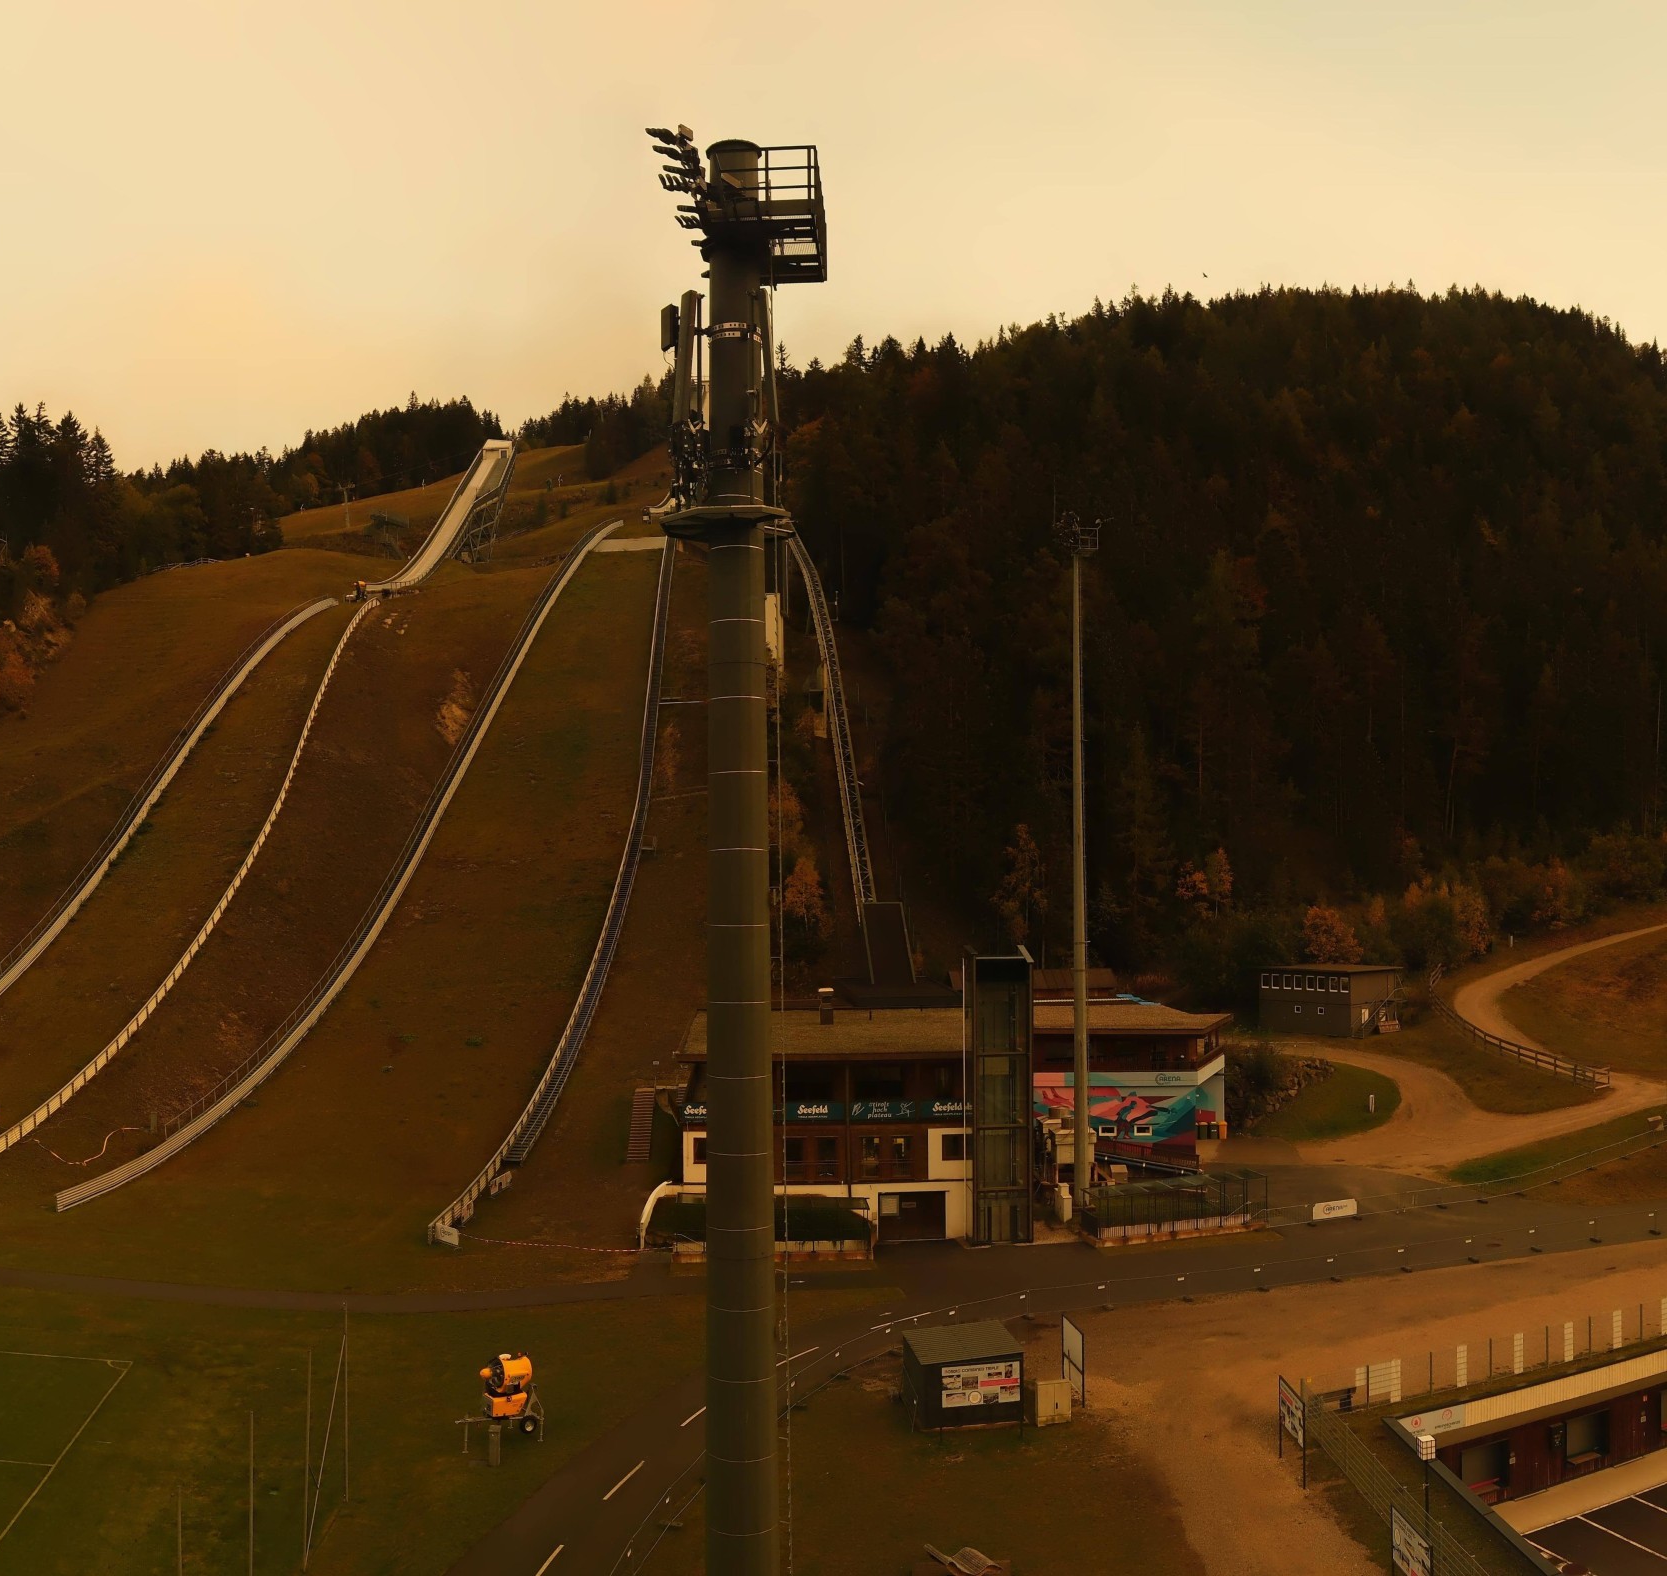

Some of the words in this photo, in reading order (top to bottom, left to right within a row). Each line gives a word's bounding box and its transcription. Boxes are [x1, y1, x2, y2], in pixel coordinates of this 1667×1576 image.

[684, 1104, 707, 1115] Seefe
[797, 1104, 828, 1115] Seefeld
[932, 1101, 963, 1112] Seefeld
